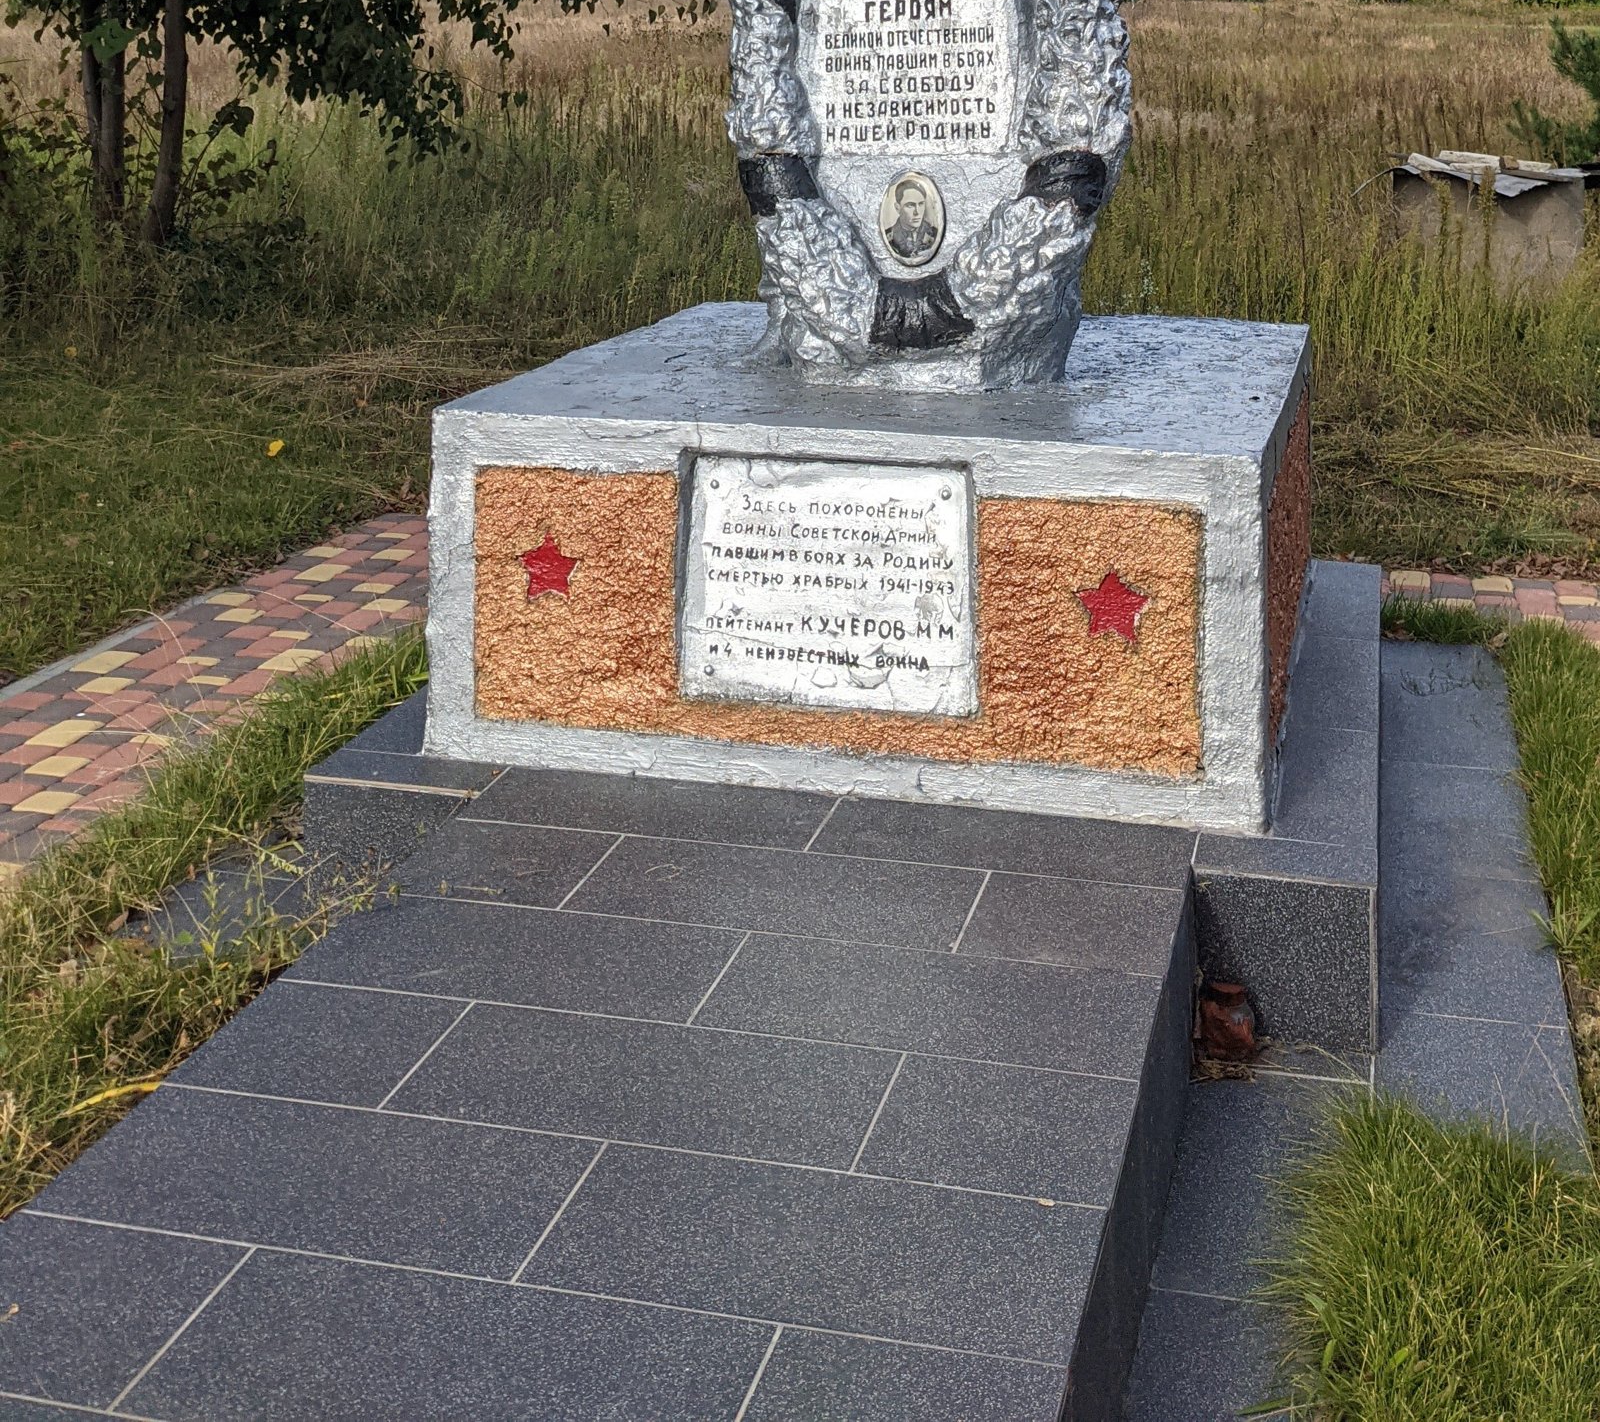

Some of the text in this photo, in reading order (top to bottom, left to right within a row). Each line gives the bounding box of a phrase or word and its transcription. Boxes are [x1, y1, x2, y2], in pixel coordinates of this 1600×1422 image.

[877, 53, 938, 70] ПАВШИМ
[943, 53, 951, 68] В
[957, 51, 994, 68] БОЯХ
[846, 75, 974, 95] ЗА СВОБОДУ
[825, 97, 996, 119] И НЕЗАВИСИМОСТЬ
[826, 119, 991, 143] НАШЕЙ РОДИНЫ
[809, 502, 924, 519] ПОХОРОНЕНЫ
[722, 522, 782, 538] ВОИНЫ
[711, 545, 954, 570] ПАВШИМ В БОЯХ ЗА РОДИНУ
[708, 569, 954, 596] СМЕРТЬЮ ХРАБРЫХ 1941-1943
[801, 615, 906, 640] КУЧЕРОВ
[917, 621, 931, 639] М
[939, 624, 953, 640] М
[724, 642, 732, 658] 4
[745, 646, 860, 669] НЕИЗВЕСТНЫХ
[875, 654, 930, 672] ВОИНА
